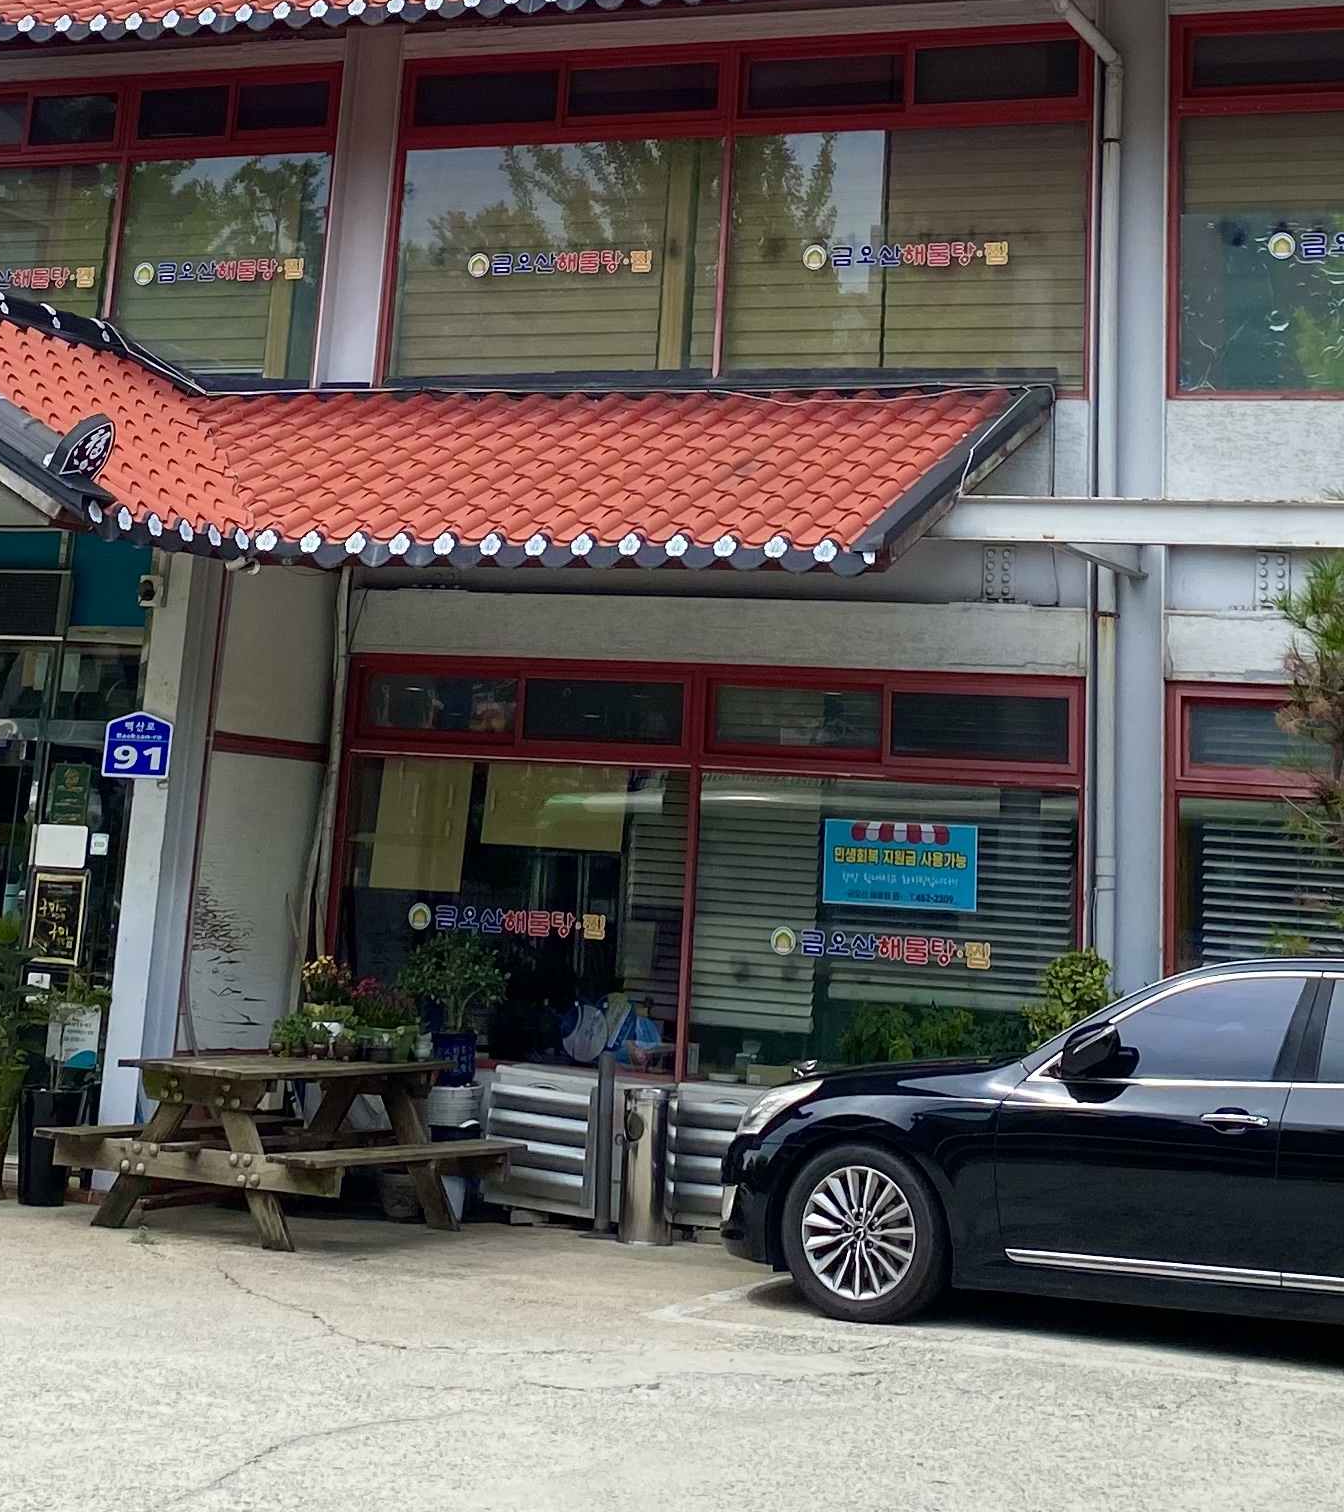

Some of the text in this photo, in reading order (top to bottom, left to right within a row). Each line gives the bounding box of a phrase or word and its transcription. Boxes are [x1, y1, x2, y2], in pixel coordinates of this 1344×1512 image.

[113, 745, 162, 770] 91
[834, 846, 968, 869] 민생회복 지원금 사용가능
